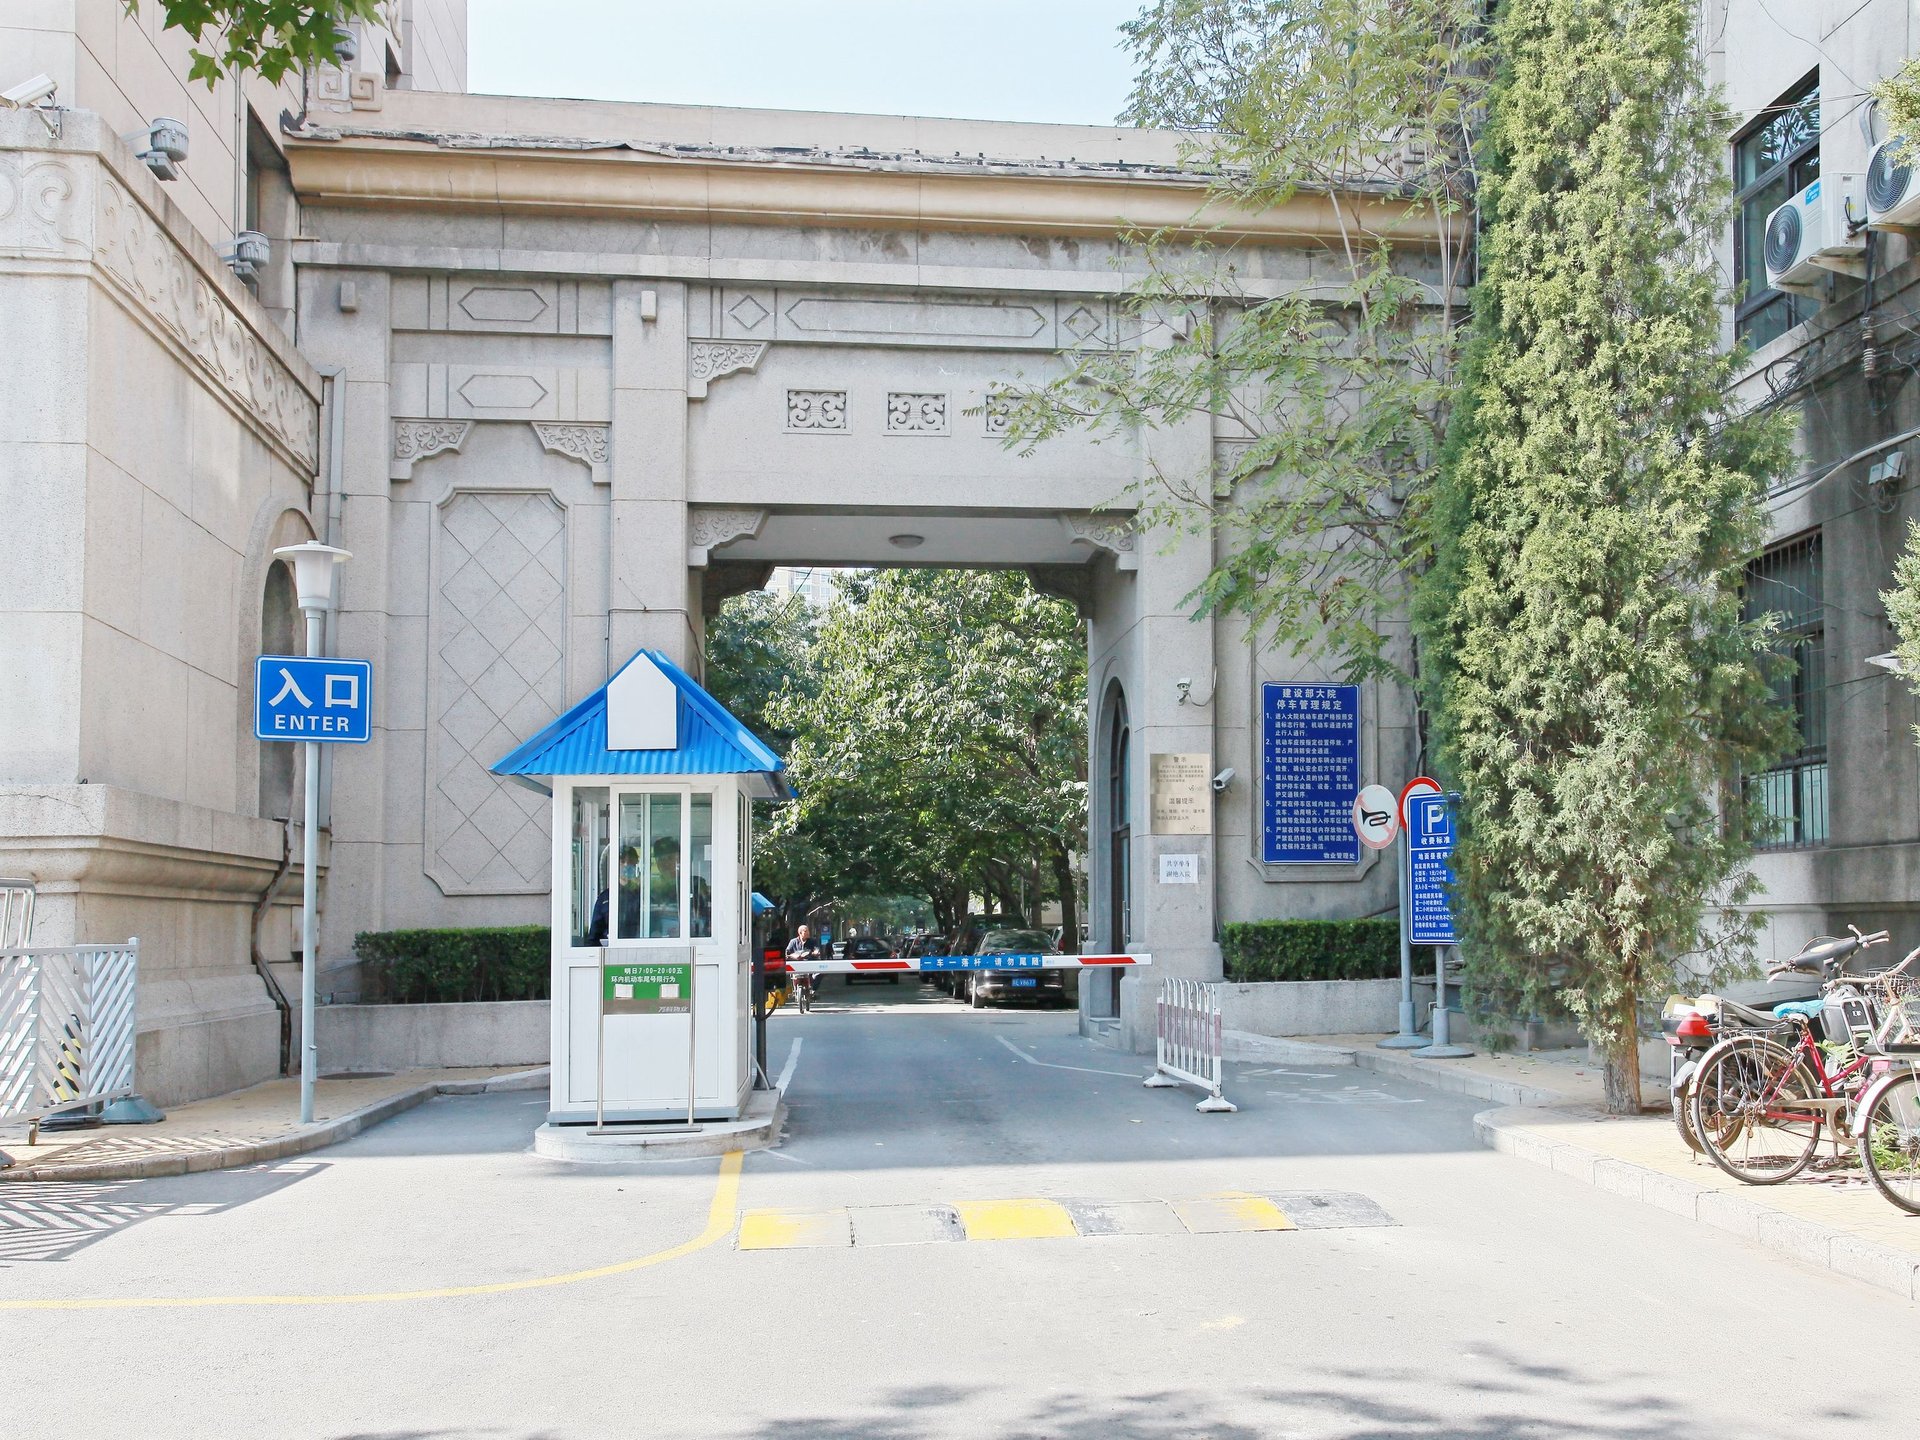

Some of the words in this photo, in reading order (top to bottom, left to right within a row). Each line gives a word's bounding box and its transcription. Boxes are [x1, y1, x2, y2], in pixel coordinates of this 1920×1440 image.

[268, 668, 358, 709] 入口
[1283, 688, 1336, 699] 建设部大院
[1277, 700, 1342, 710] 停车管理规定
[275, 715, 349, 732] ENTER
[1421, 836, 1450, 845] 收费标准
